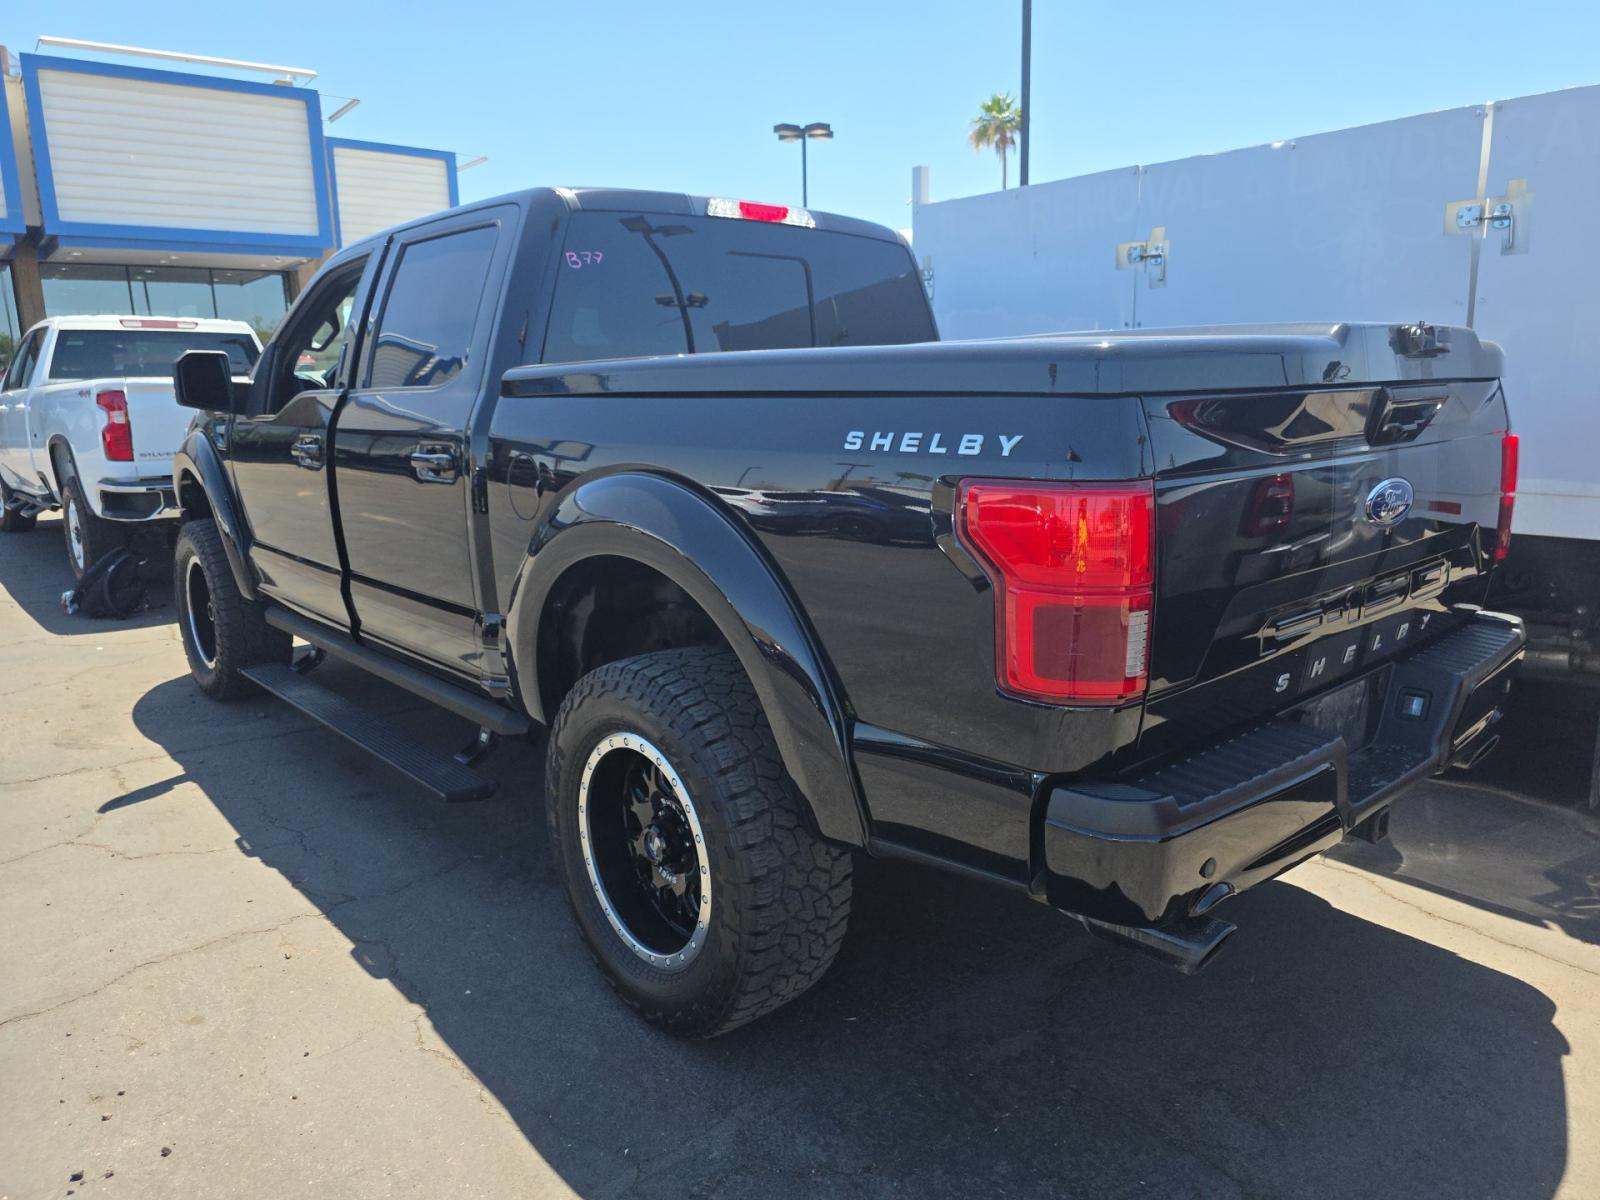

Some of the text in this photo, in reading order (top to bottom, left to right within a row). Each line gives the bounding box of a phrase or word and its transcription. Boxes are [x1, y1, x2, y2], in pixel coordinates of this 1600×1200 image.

[565, 251, 603, 268] B77
[844, 431, 1024, 457] SHELBY
[1275, 613, 1431, 693] SHELBY
